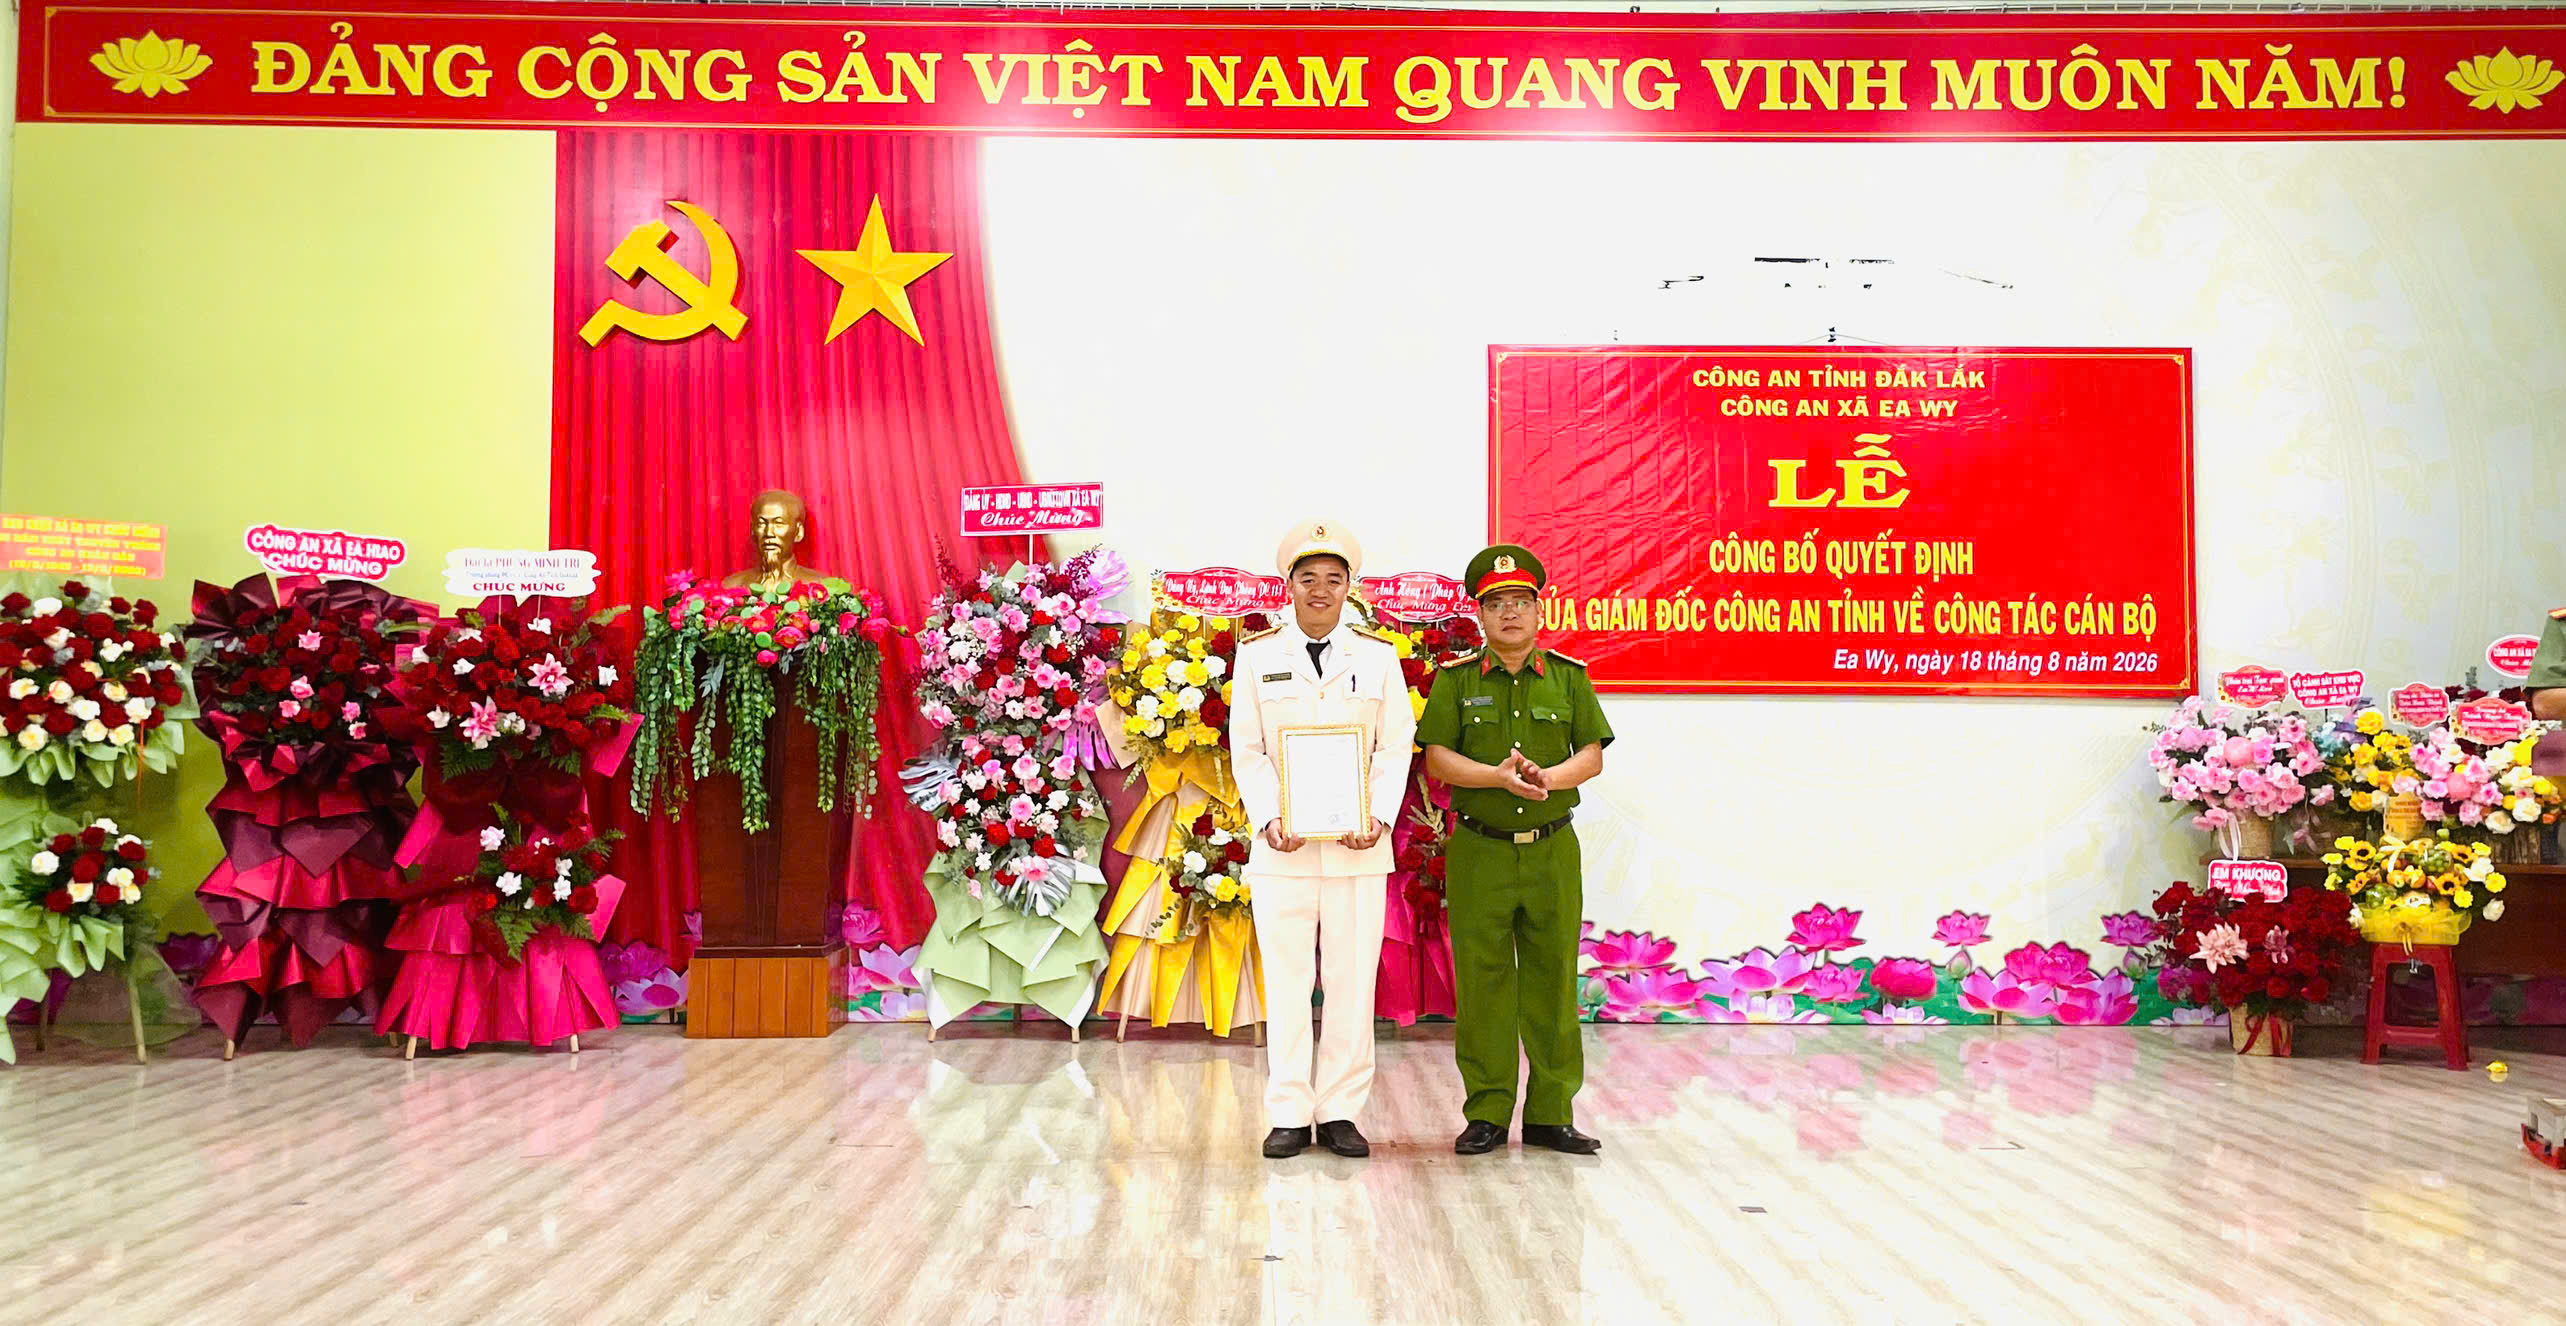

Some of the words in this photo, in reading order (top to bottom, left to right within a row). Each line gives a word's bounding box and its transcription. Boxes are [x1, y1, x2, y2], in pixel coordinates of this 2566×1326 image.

[251, 22, 493, 97] ĐẢNG
[517, 32, 753, 112] CỘNG
[776, 31, 943, 103] SẢN
[962, 39, 1164, 119] VIỆT
[1185, 55, 1369, 107] NAM
[1393, 55, 1681, 123] QUANG
[1700, 59, 1908, 111] VINH
[1930, 43, 2172, 111] MUÔN
[2195, 43, 2406, 110] NĂM!
[1692, 365, 1761, 387] CÔNG
[1767, 369, 1801, 388] AN
[1807, 364, 1867, 388] TỈNH
[1875, 364, 1928, 388] ĐẮK
[1935, 363, 1985, 389] LẮK
[1720, 394, 1788, 417] CÔNG
[1795, 399, 1829, 417] AN
[1837, 395, 1870, 417] XÃ
[1879, 399, 1911, 418] EA
[1919, 399, 1958, 418] WY
[1767, 433, 1911, 509] LỄ
[980, 512, 1024, 527] Chúc
[251, 530, 296, 551] CÔNG
[297, 537, 320, 553] AN
[322, 535, 343, 555] XÃ
[1709, 531, 1776, 574] CÔNG
[1783, 527, 1820, 574] BỐ
[1825, 528, 1907, 580] QUYẾT
[1914, 541, 1974, 583] ĐỊNH
[268, 552, 323, 570] CHÚC
[327, 556, 383, 575] MỪNG
[1585, 588, 1648, 631] GIÁM
[1654, 585, 1707, 632] ĐỐC
[1713, 590, 1781, 633] CÔNG
[1787, 599, 1821, 633] AN
[1827, 587, 1885, 633] TỈNH
[1893, 586, 1925, 633] VỀ
[1934, 591, 2001, 635] CÔNG
[2007, 592, 2057, 635] TÁC
[2064, 593, 2114, 635] CÁN
[2122, 593, 2157, 643] BỘ
[1833, 648, 1859, 670] Ea
[1865, 649, 1899, 675] Wy,
[1905, 649, 1955, 676] ngày
[1960, 650, 1982, 671] 18
[1987, 650, 2043, 677] tháng
[2047, 651, 2061, 672] 8
[2065, 651, 2108, 672] năm
[2112, 651, 2158, 673] 2026
